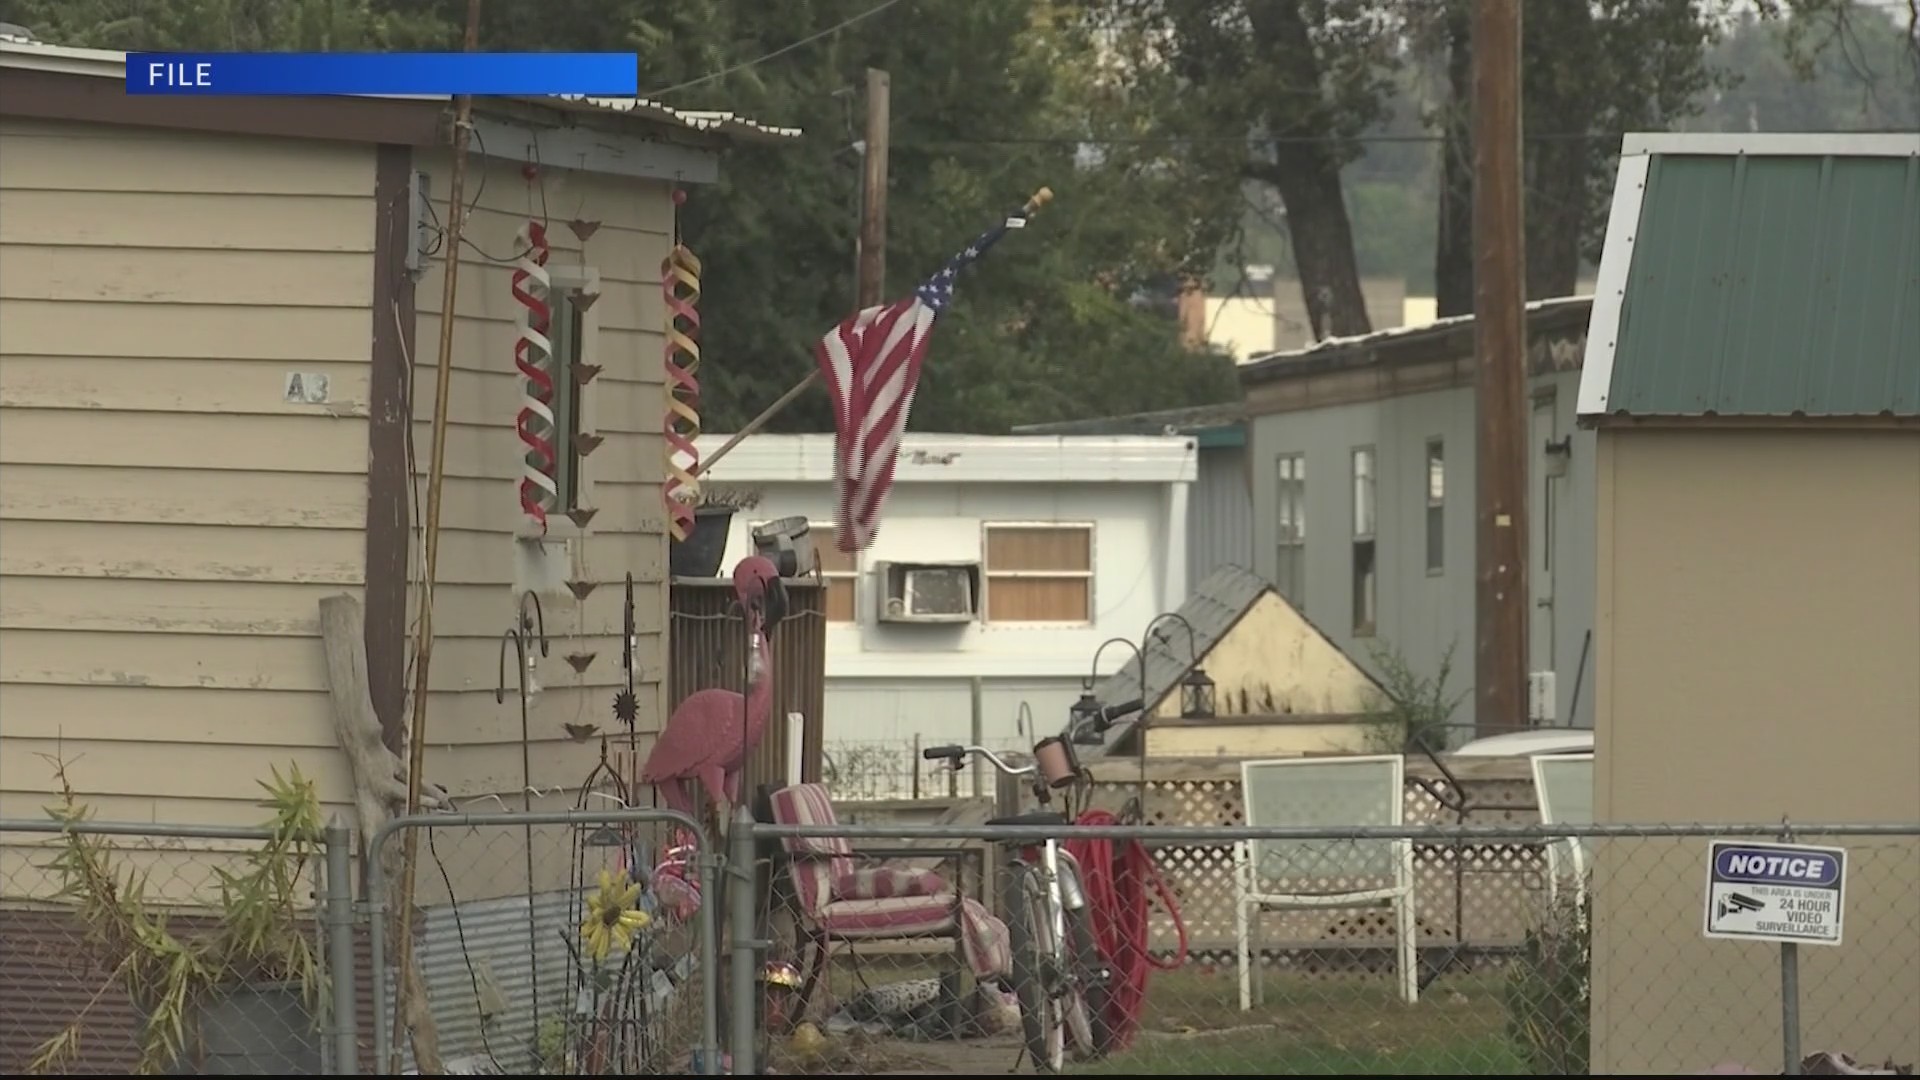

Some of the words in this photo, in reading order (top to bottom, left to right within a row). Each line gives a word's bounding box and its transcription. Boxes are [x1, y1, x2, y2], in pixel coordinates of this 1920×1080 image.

[1728, 855, 1824, 878] NOTICE
[1752, 887, 1769, 896] THIS
[1771, 888, 1792, 897] AREA
[1793, 889, 1801, 898] IS
[1803, 890, 1832, 899] UNDER
[1780, 898, 1794, 910] 24
[1798, 899, 1831, 912] HOUR
[1787, 911, 1822, 924] VIDEO
[1756, 921, 1829, 935] SURVEILLANCE
